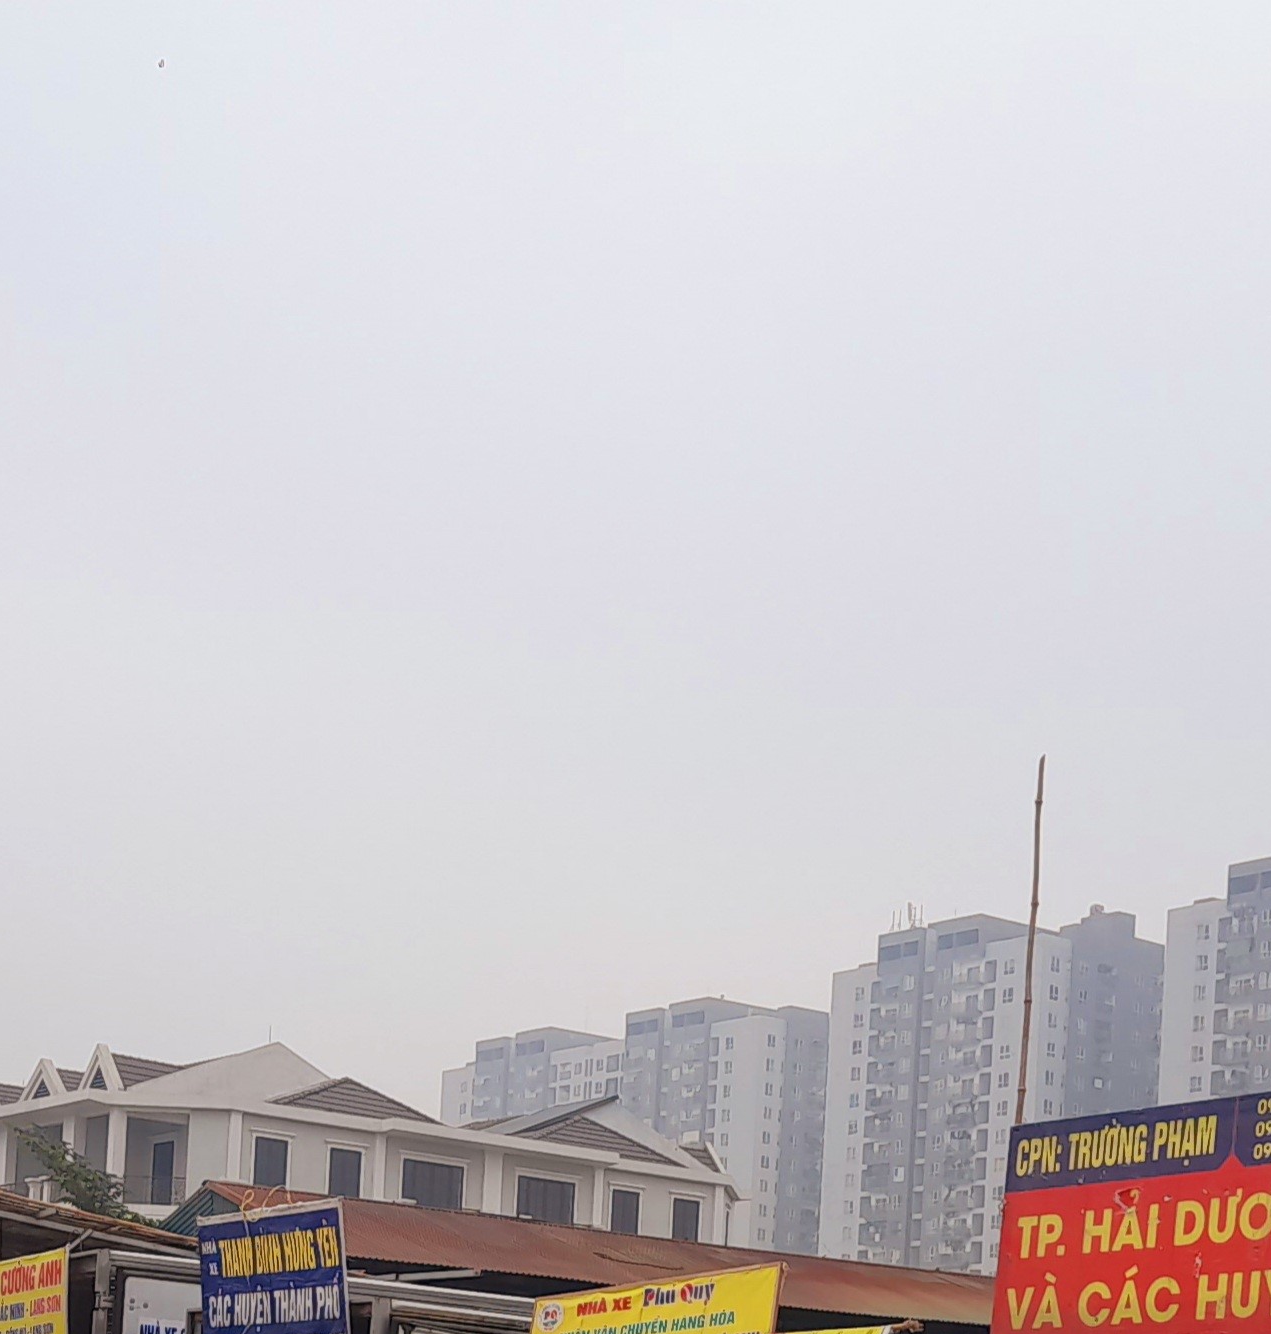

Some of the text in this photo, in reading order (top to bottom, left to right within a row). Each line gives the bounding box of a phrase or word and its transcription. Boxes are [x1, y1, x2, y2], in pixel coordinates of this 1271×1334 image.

[1015, 1115, 1218, 1177] CPN: TRƯỜNG PHẠM
[1017, 1214, 1065, 1259] TP.
[1082, 1190, 1160, 1255] HẢI
[38, 1259, 62, 1289] ANH
[218, 1236, 254, 1278] THANH
[209, 1272, 341, 1333] CÁC HUYỆN THÀNH PHỐ
[577, 1297, 608, 1317] NHÀ
[611, 1296, 632, 1311] XE
[1007, 1273, 1064, 1331] VÀ
[1077, 1265, 1180, 1328] CÁC
